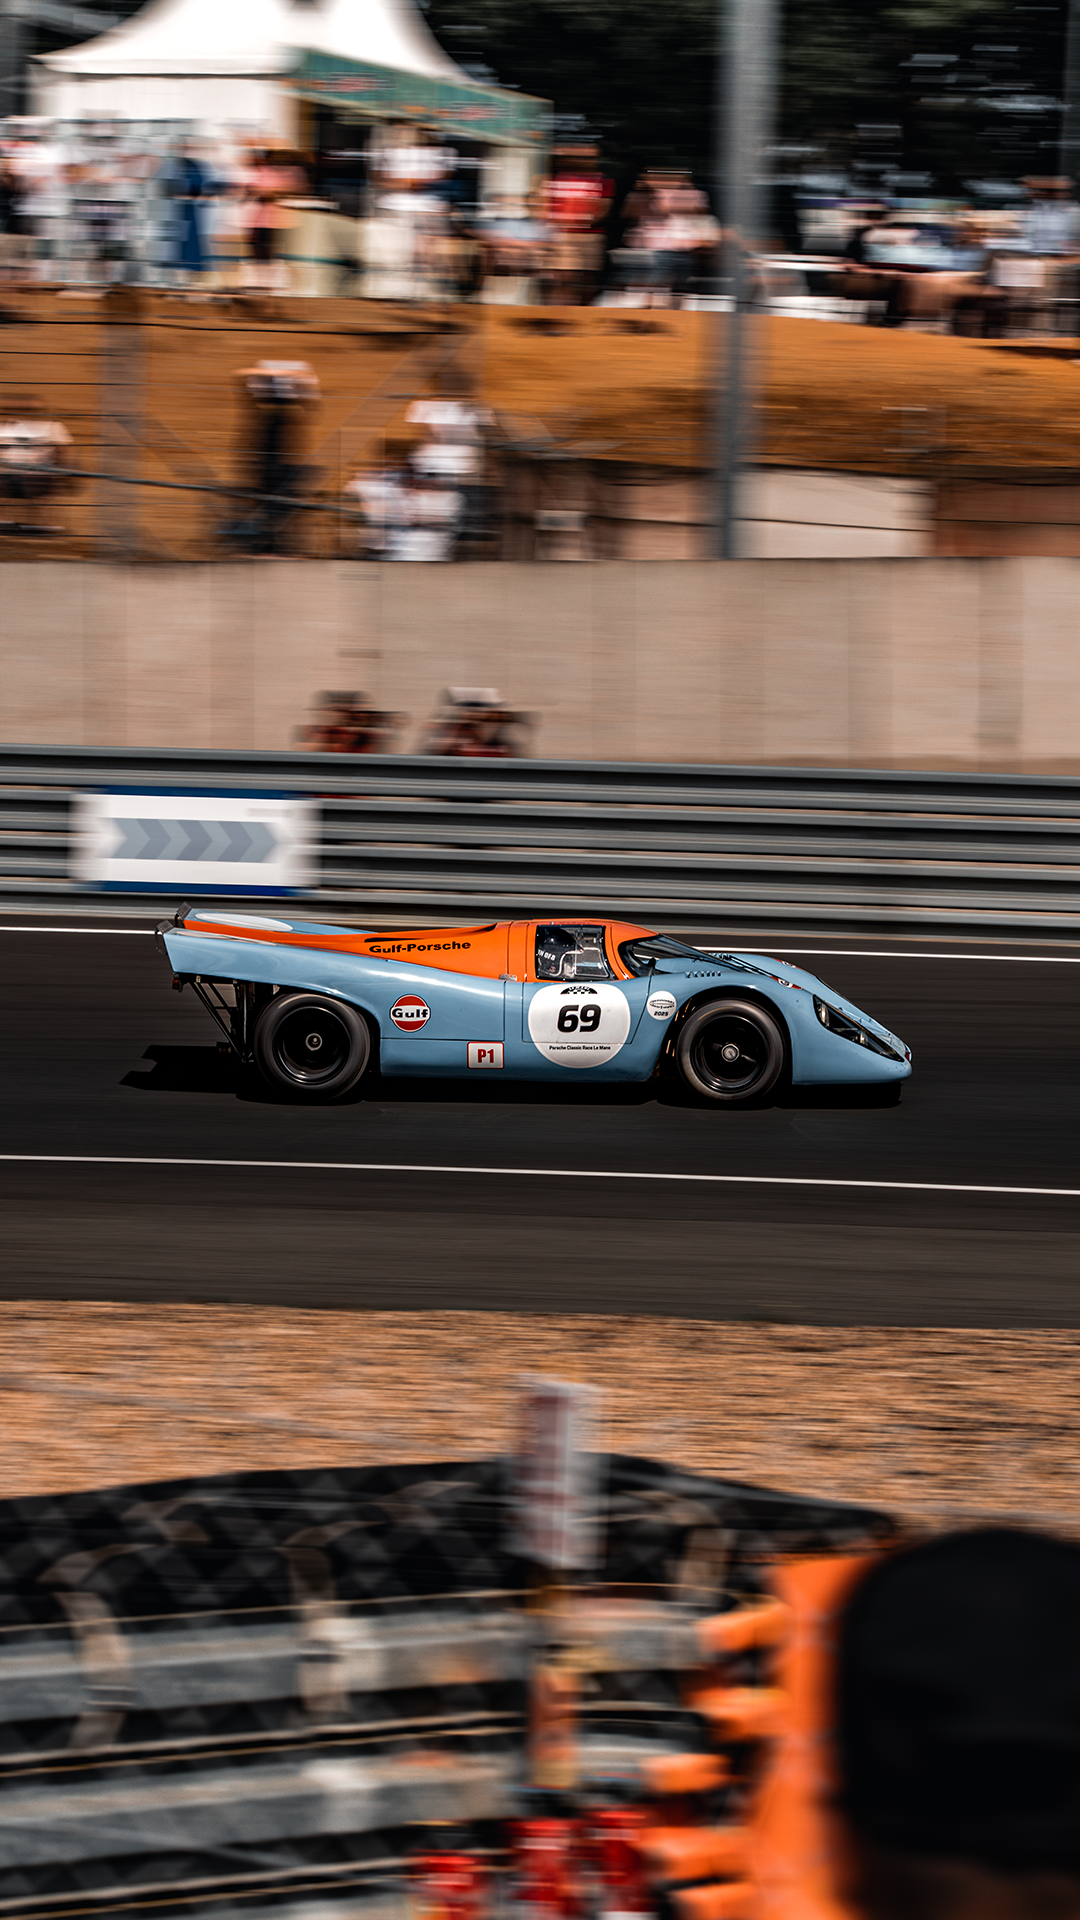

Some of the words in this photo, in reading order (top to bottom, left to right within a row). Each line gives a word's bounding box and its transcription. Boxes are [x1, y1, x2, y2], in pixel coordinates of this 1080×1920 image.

[369, 941, 472, 953] Gulf-Porsche
[391, 1008, 429, 1019] Gulf
[557, 1004, 602, 1033] 69
[477, 1048, 495, 1064] P1
